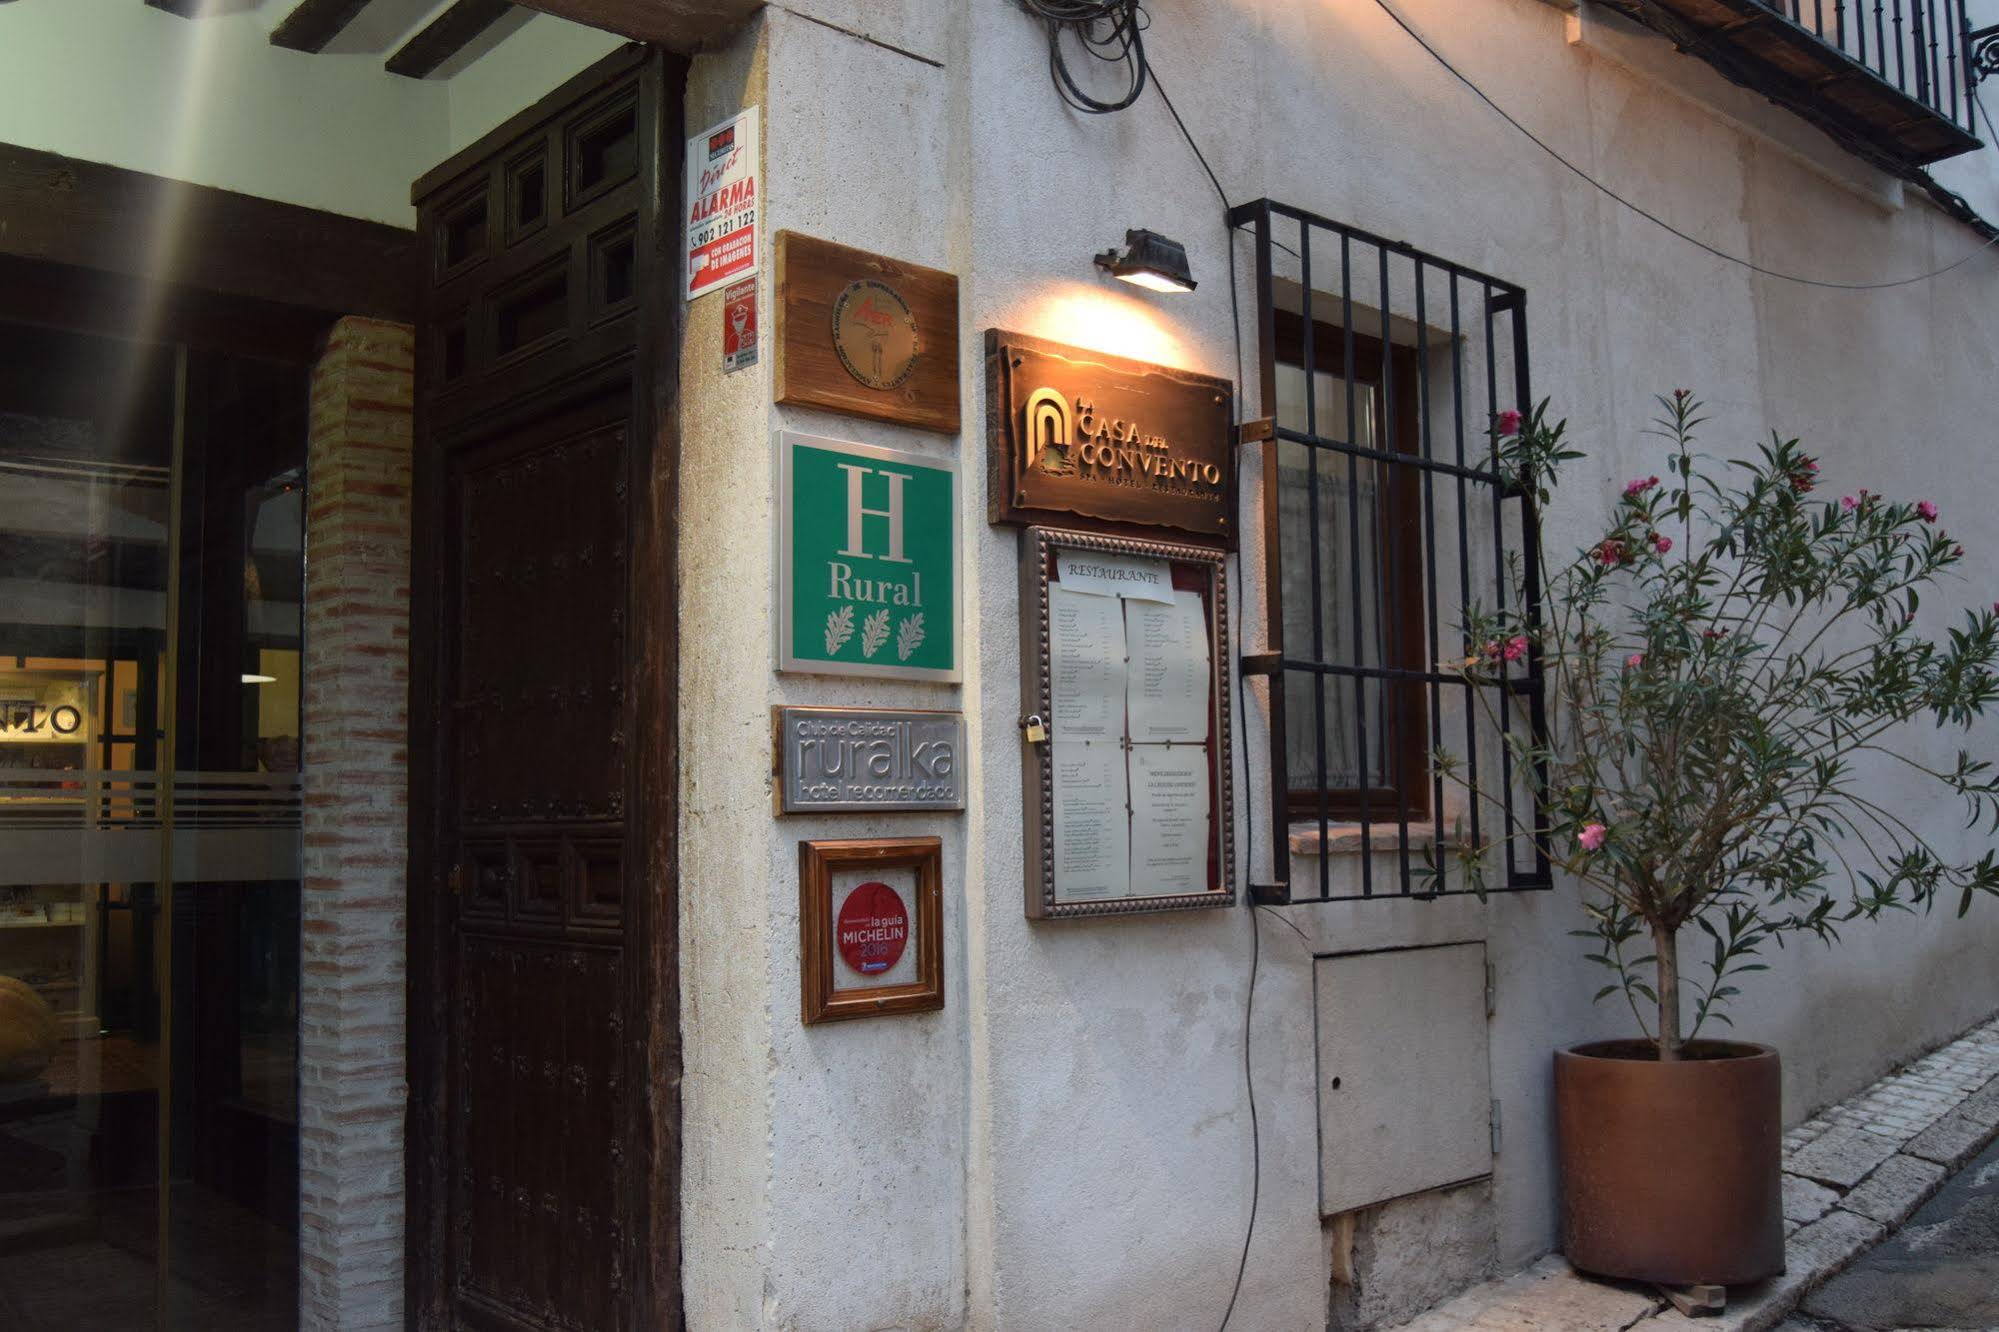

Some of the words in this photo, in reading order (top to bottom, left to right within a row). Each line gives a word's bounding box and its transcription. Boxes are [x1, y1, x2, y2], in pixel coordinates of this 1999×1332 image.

[689, 176, 755, 225] ALARMA
[698, 229, 715, 246] 902
[719, 219, 733, 237] 121
[739, 210, 755, 228] 122
[711, 258, 719, 271] DE
[1079, 414, 1141, 444] CASA
[1080, 443, 1221, 485] CONVENTO
[837, 463, 913, 564] H
[827, 561, 923, 607] Rural
[1067, 563, 1160, 585] RESTAURANTE
[849, 720, 895, 737] Calidad
[799, 721, 953, 779] ruralka
[799, 780, 842, 799] hotel
[847, 780, 953, 800] recomendado
[843, 928, 904, 944] MICHELIN
[871, 916, 880, 927] la
